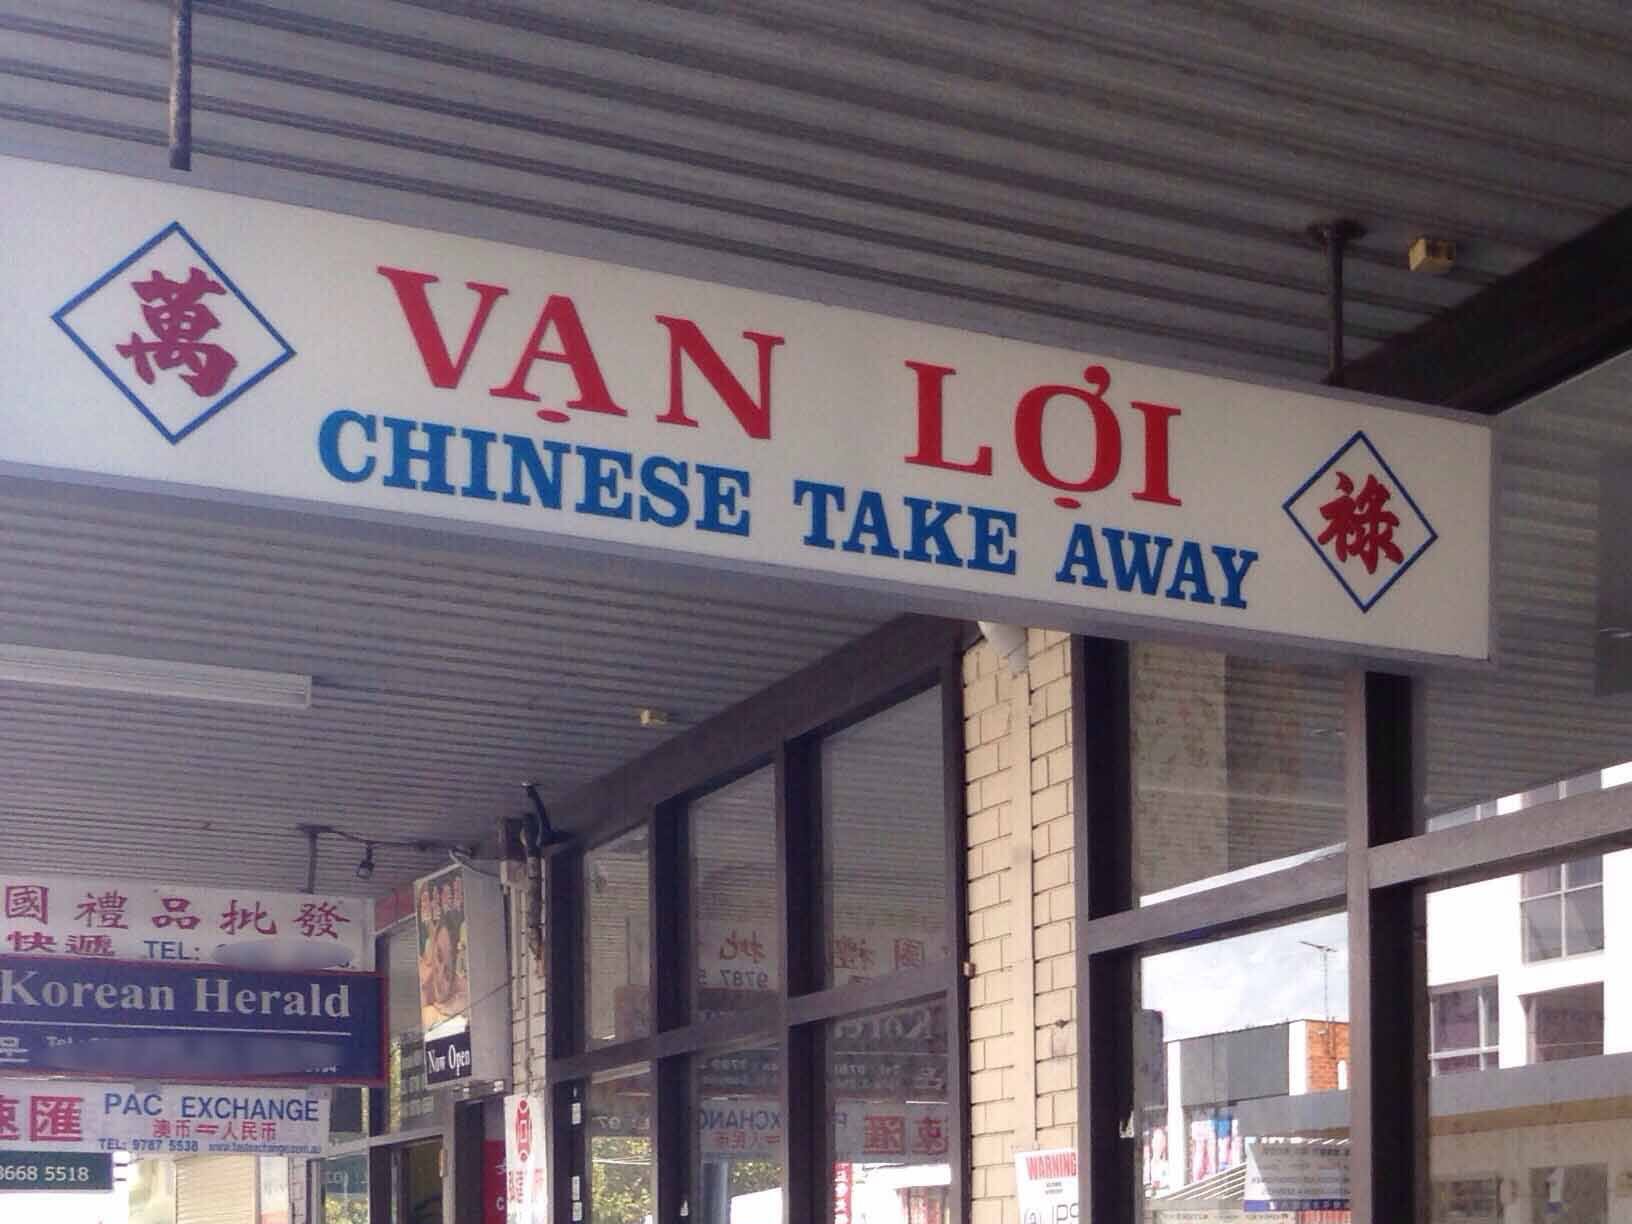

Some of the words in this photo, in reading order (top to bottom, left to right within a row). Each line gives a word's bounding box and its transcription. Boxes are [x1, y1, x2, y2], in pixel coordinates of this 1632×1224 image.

[116, 267, 239, 397] 萬
[377, 265, 784, 440] VẠN
[318, 409, 750, 537] CHINESE
[793, 479, 1017, 575] TAKE
[1055, 522, 1258, 610] AWAY
[144, 939, 200, 962] TEL:
[0, 969, 175, 1012] Korean
[192, 977, 350, 1018] Herald
[449, 1044, 470, 1077] Open
[104, 1093, 163, 1116] PAC
[181, 1096, 319, 1122] EXCHANGE
[97, 1138, 128, 1151] TEL:
[45, 1166, 89, 1181] 5518
[1025, 1152, 1078, 1181] WARNING
